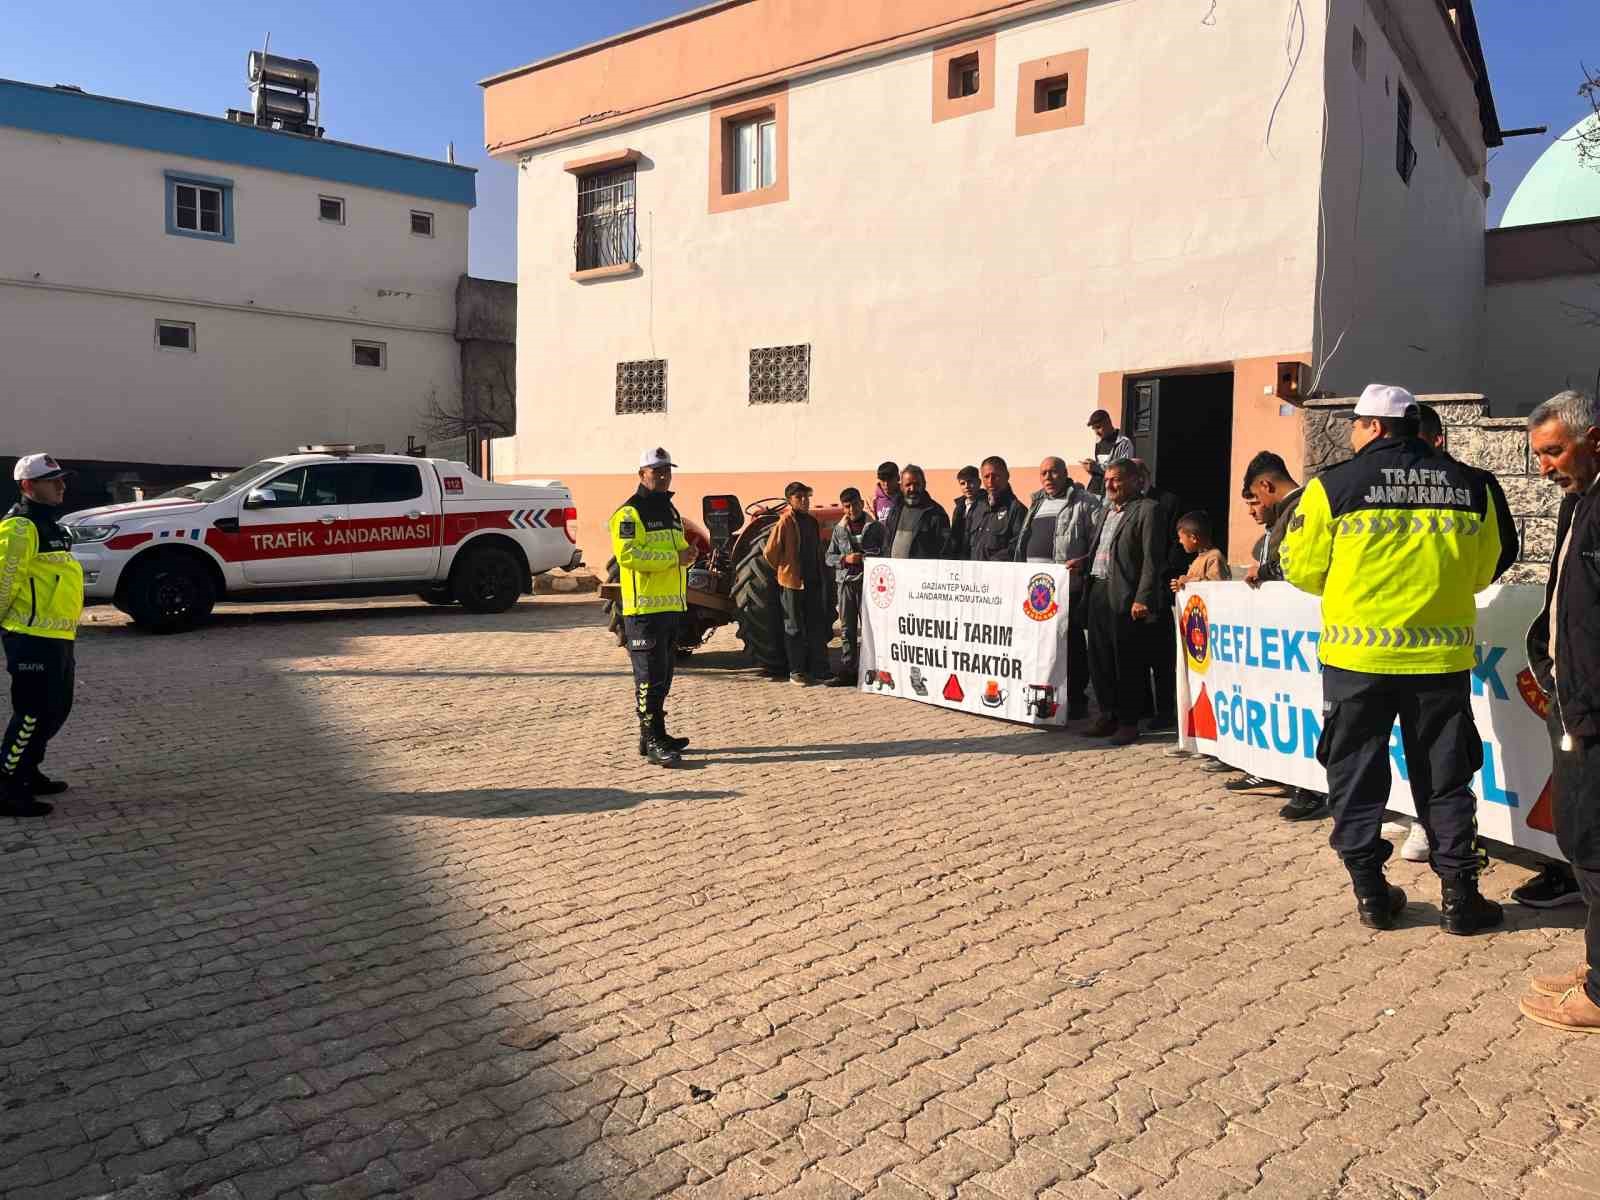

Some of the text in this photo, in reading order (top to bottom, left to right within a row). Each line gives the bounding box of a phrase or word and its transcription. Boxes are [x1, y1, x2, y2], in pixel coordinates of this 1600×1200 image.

[1364, 485, 1471, 506] JANDARMASI
[251, 524, 431, 550] TRAFİK JANDARMASI
[898, 613, 1013, 647] GÜVENLİ TARIM
[891, 641, 1023, 680] GÜVENLİ TRAKTÖR
